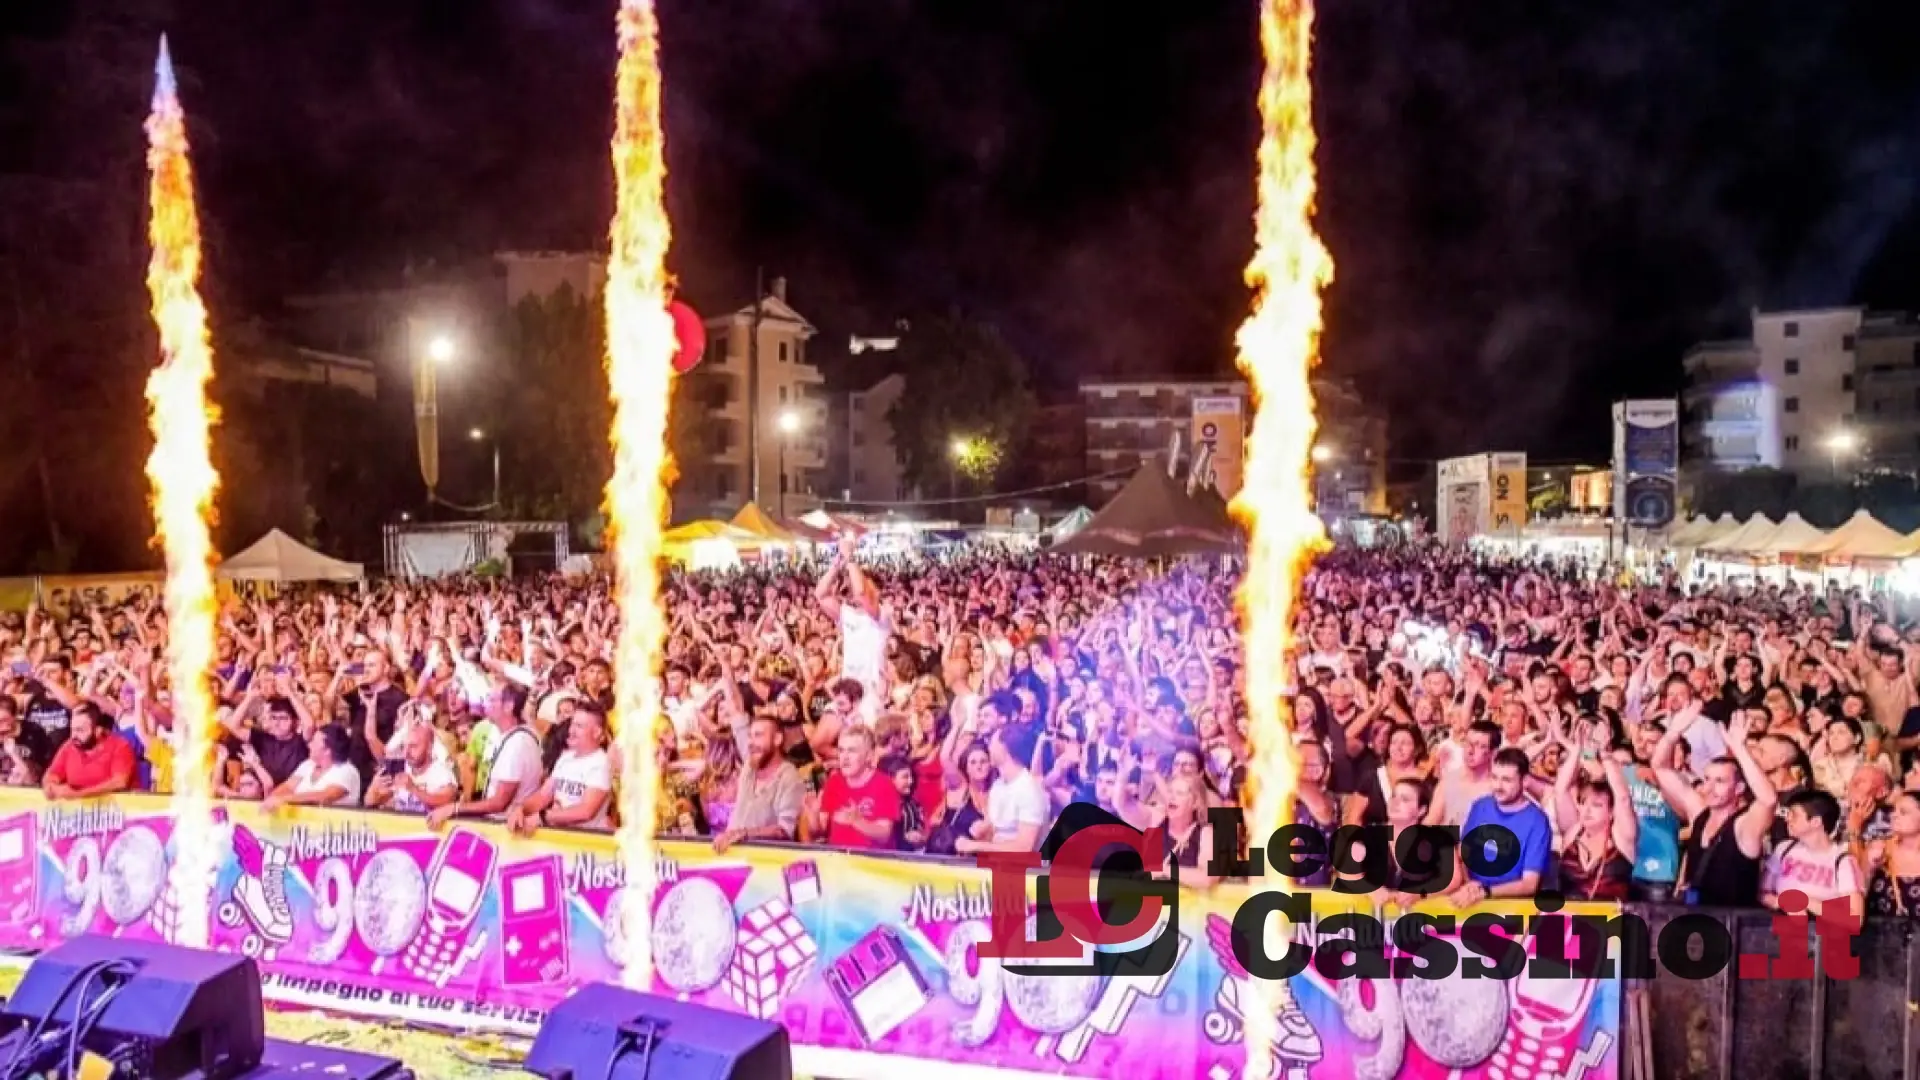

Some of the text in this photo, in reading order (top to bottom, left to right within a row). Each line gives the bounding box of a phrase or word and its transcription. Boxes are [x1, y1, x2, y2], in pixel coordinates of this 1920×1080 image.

[42, 803, 123, 846] Nostalgia
[286, 822, 377, 870] Nostalgia
[308, 850, 426, 967] 90
[276, 974, 384, 1002] impegno
